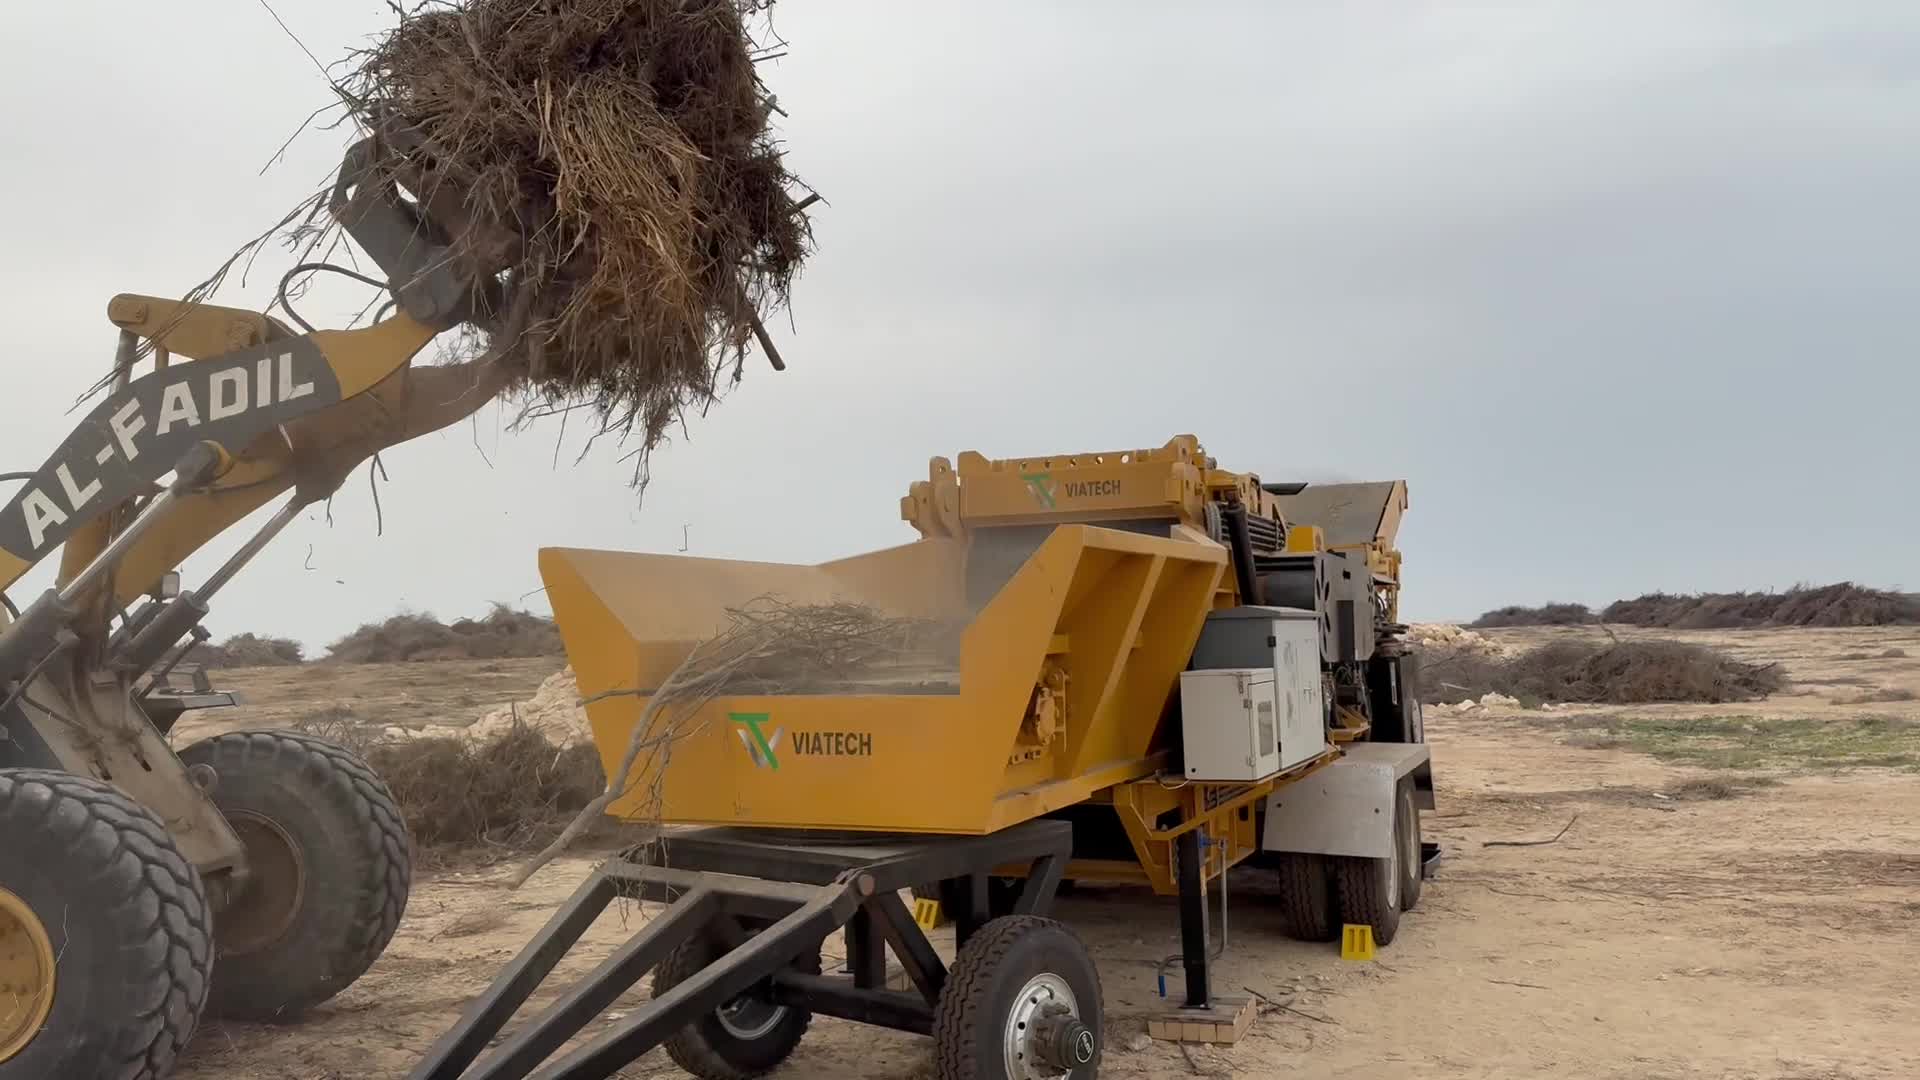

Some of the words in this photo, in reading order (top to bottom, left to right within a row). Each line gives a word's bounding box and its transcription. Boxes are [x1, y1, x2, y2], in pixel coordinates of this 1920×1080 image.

[21, 352, 314, 550] AL-FADIL
[1065, 480, 1120, 497] VIATECH
[792, 732, 872, 755] VIATECH
